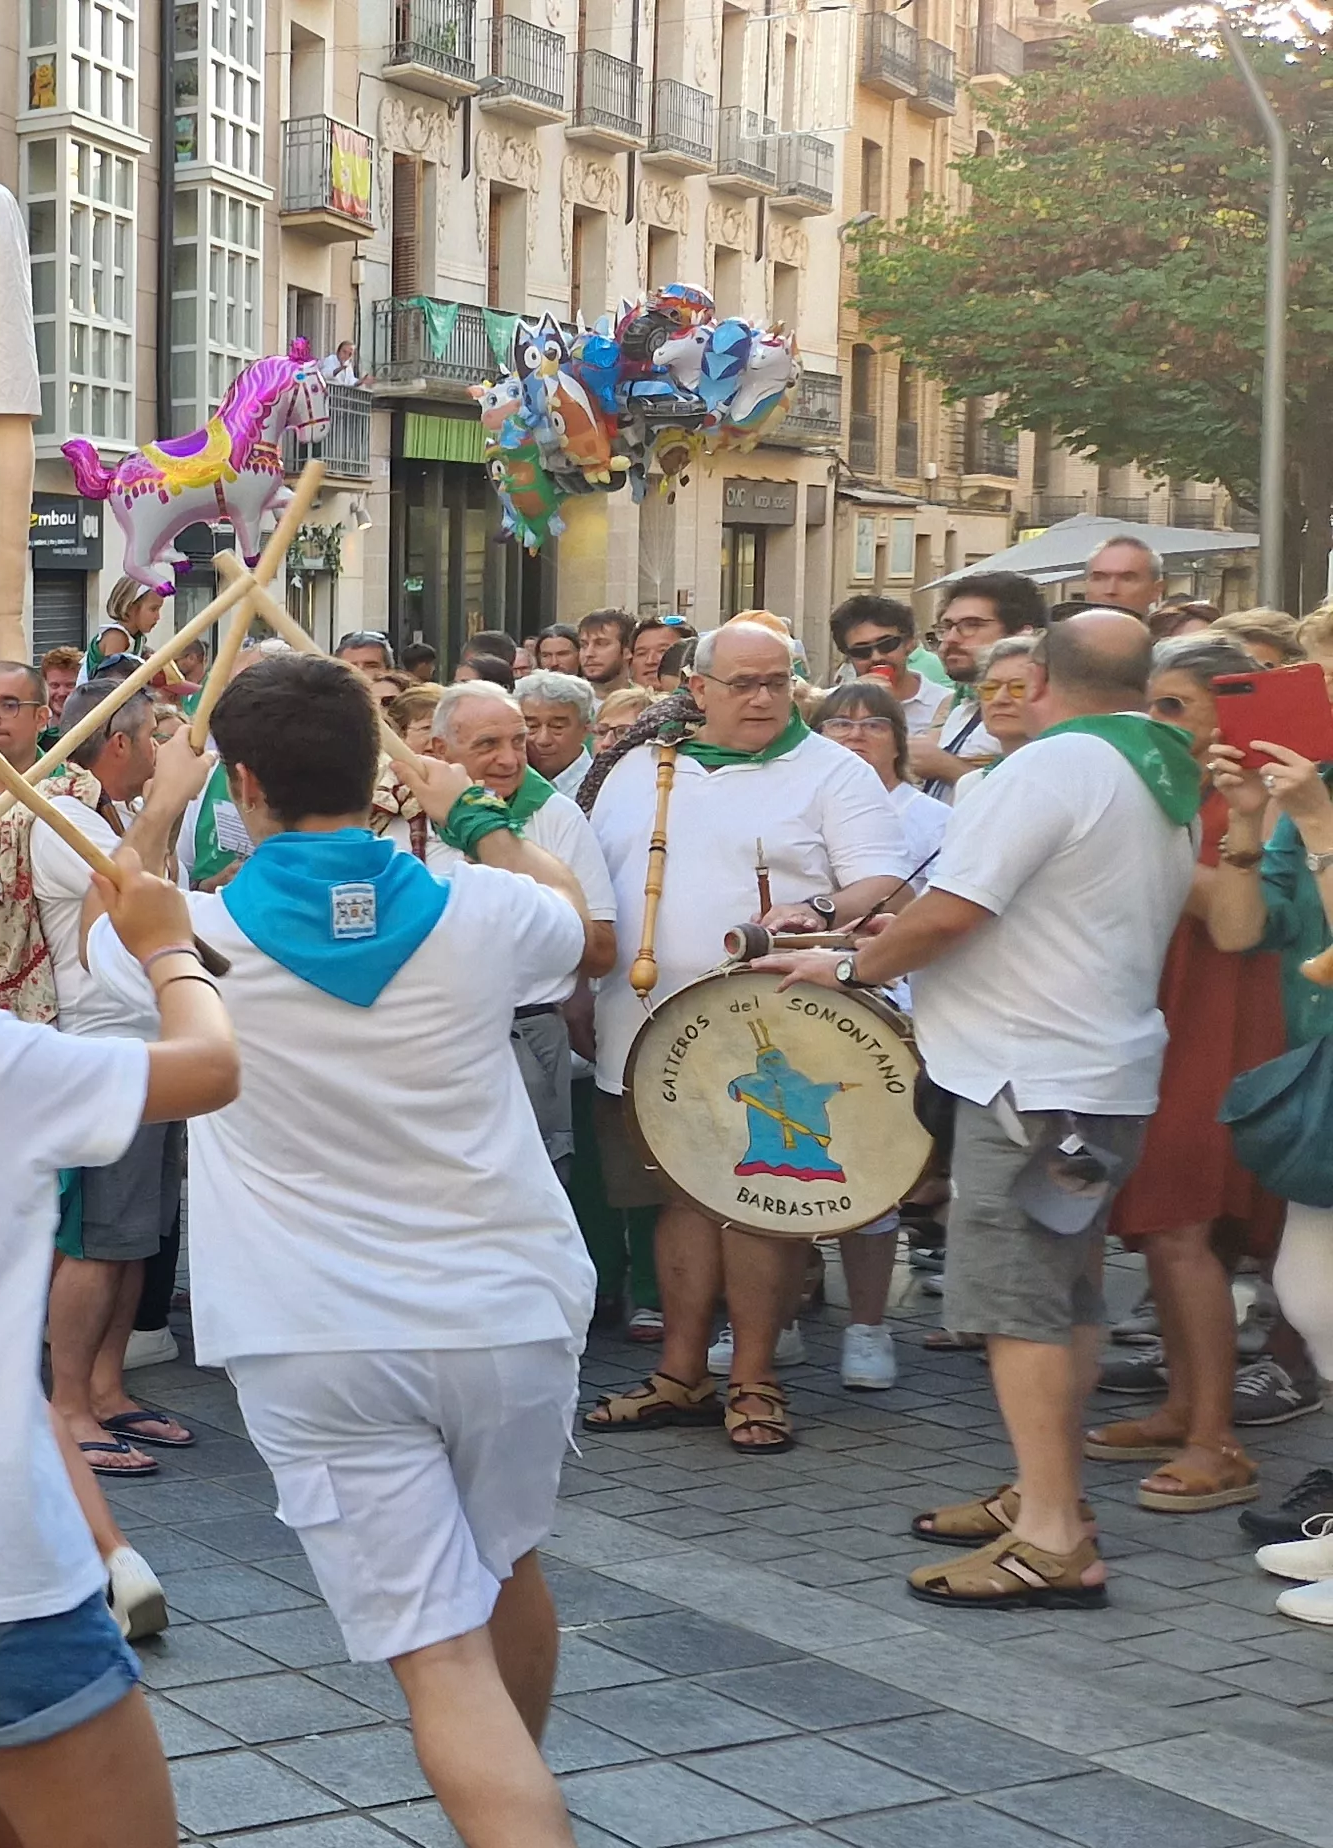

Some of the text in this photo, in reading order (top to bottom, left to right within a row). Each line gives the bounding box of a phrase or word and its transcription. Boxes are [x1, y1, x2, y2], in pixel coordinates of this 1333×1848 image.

[663, 995, 907, 1103] GAITEROS del SOMONTANO
[736, 1186, 852, 1217] BARBASTRO
